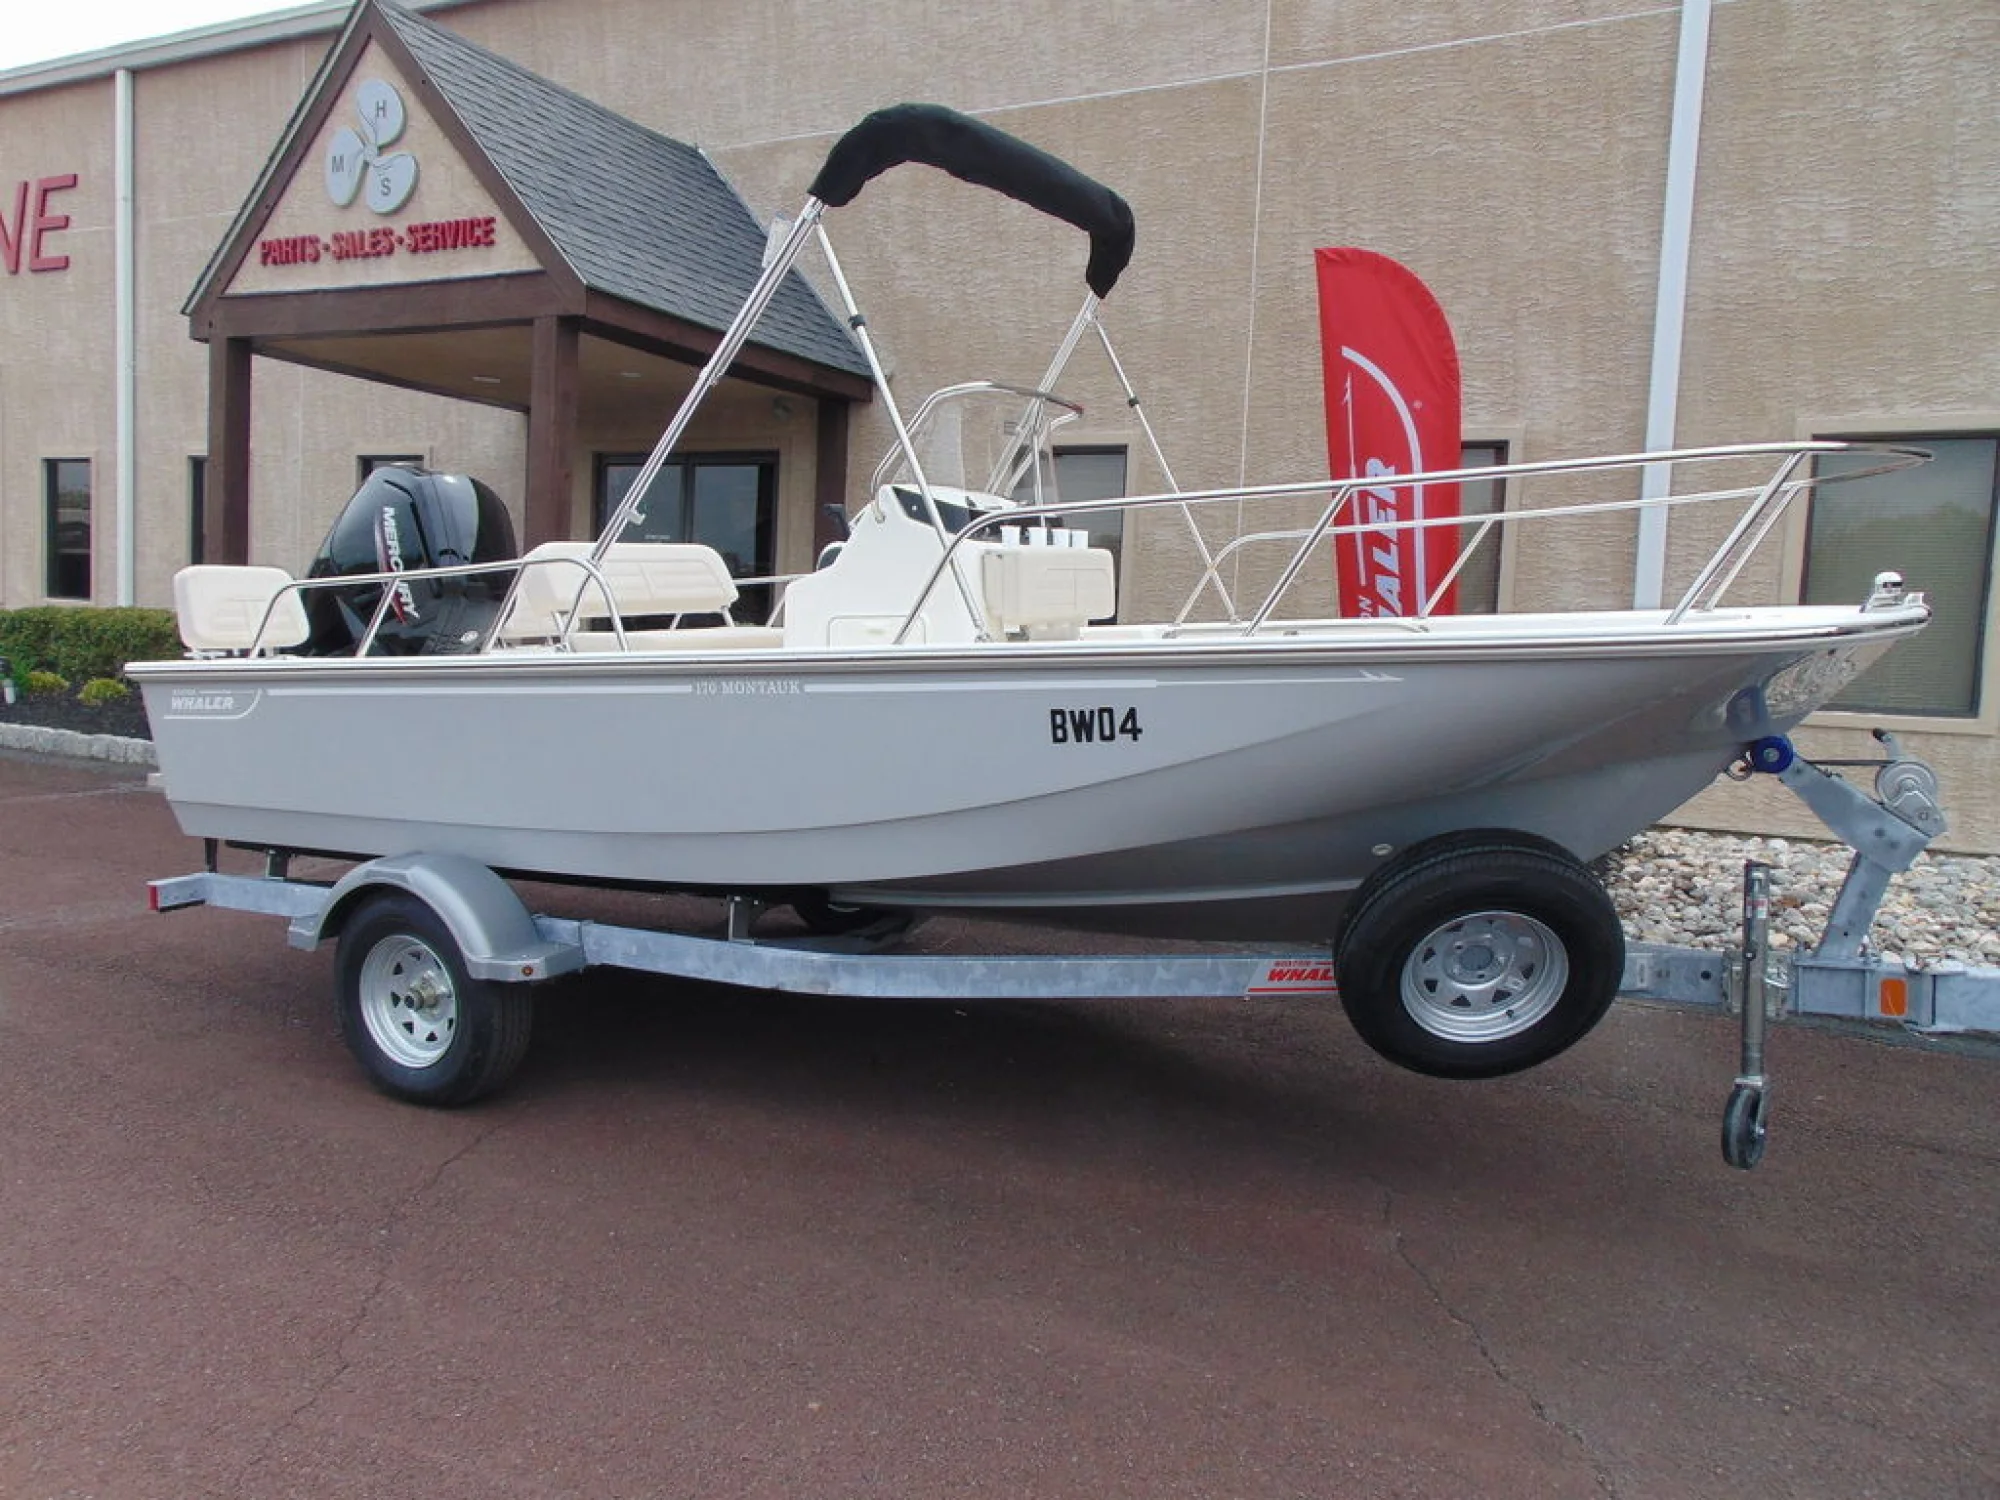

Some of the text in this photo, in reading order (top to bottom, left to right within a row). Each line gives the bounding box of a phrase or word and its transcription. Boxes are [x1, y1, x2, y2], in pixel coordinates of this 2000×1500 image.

[376, 100, 388, 118] H
[332, 155, 345, 173] M
[380, 178, 391, 196] S
[260, 216, 497, 266] PARTS SALES SERVICE
[1365, 457, 1403, 618] ALER
[382, 506, 421, 619] MERCRY
[720, 678, 801, 694] MONTAUK
[171, 696, 235, 711] WHALER
[1050, 706, 1143, 743] BW04
